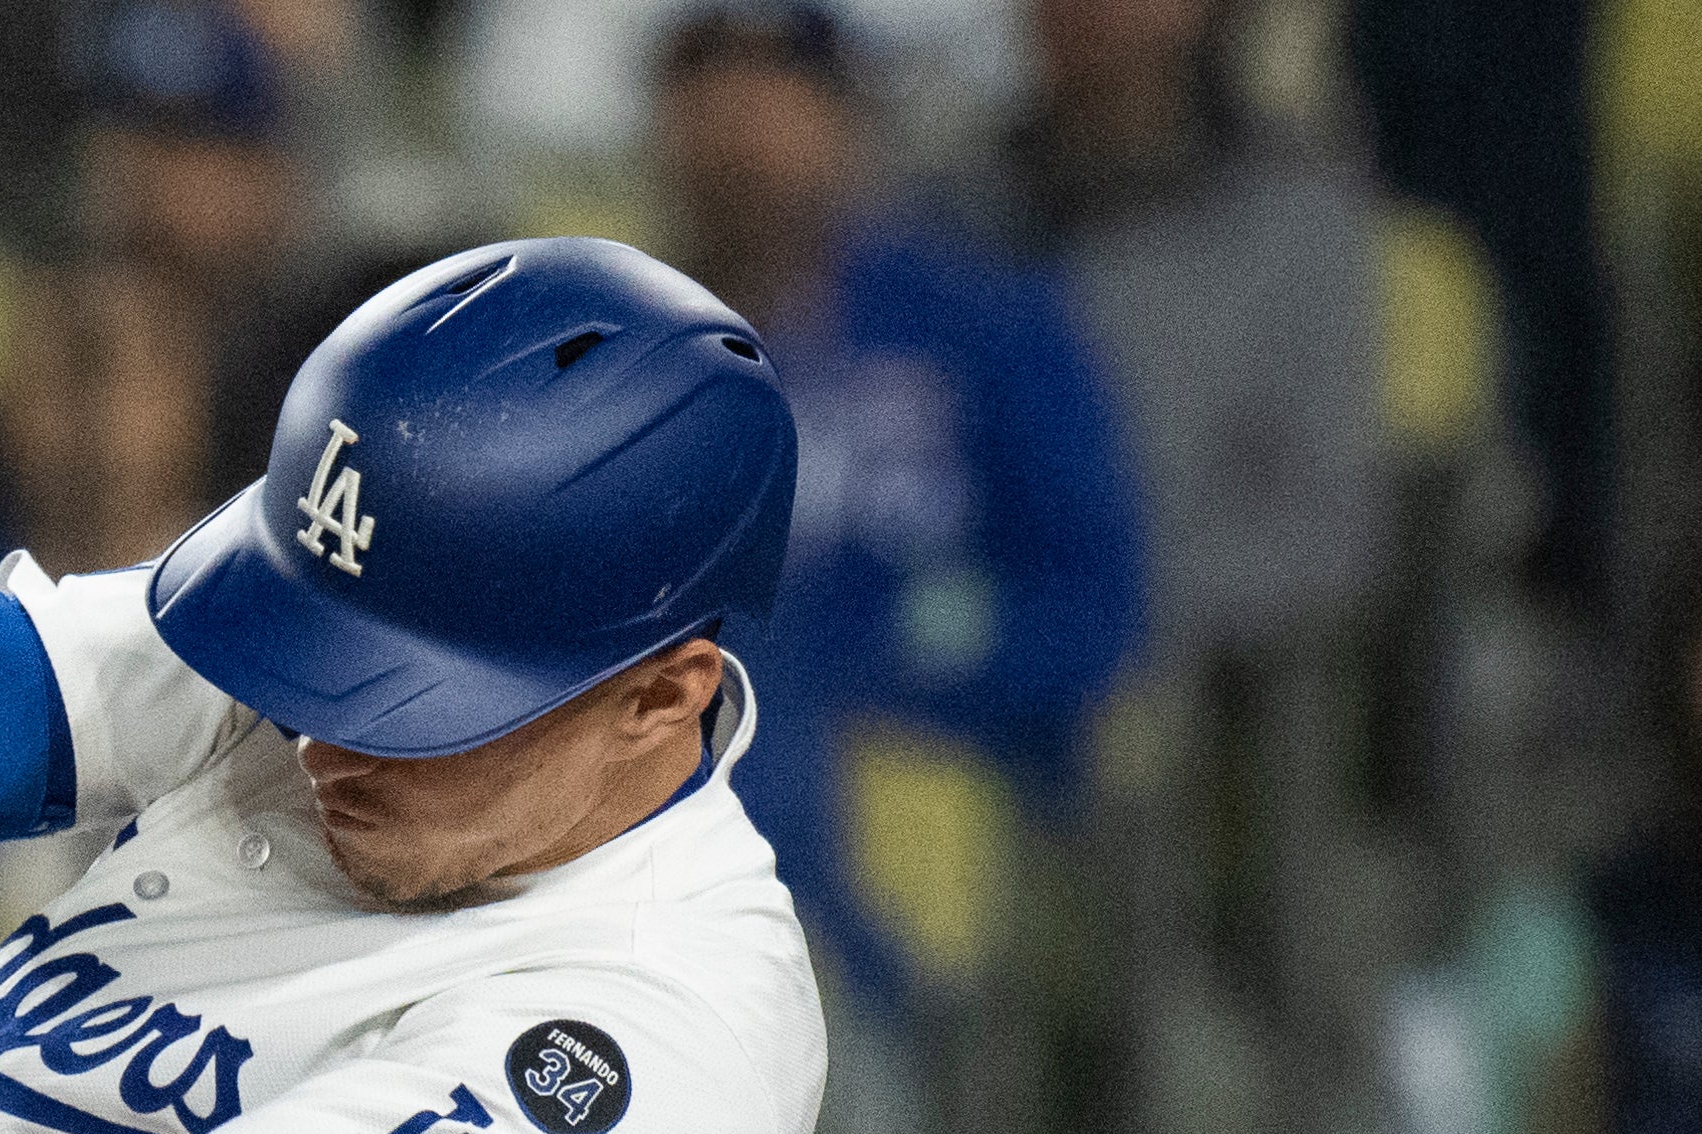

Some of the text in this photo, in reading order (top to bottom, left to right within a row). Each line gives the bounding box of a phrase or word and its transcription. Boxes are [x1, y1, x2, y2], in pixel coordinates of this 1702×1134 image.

[297, 418, 375, 578] LA
[524, 1048, 604, 1127] 34
[546, 1028, 619, 1086] FERNANDO
